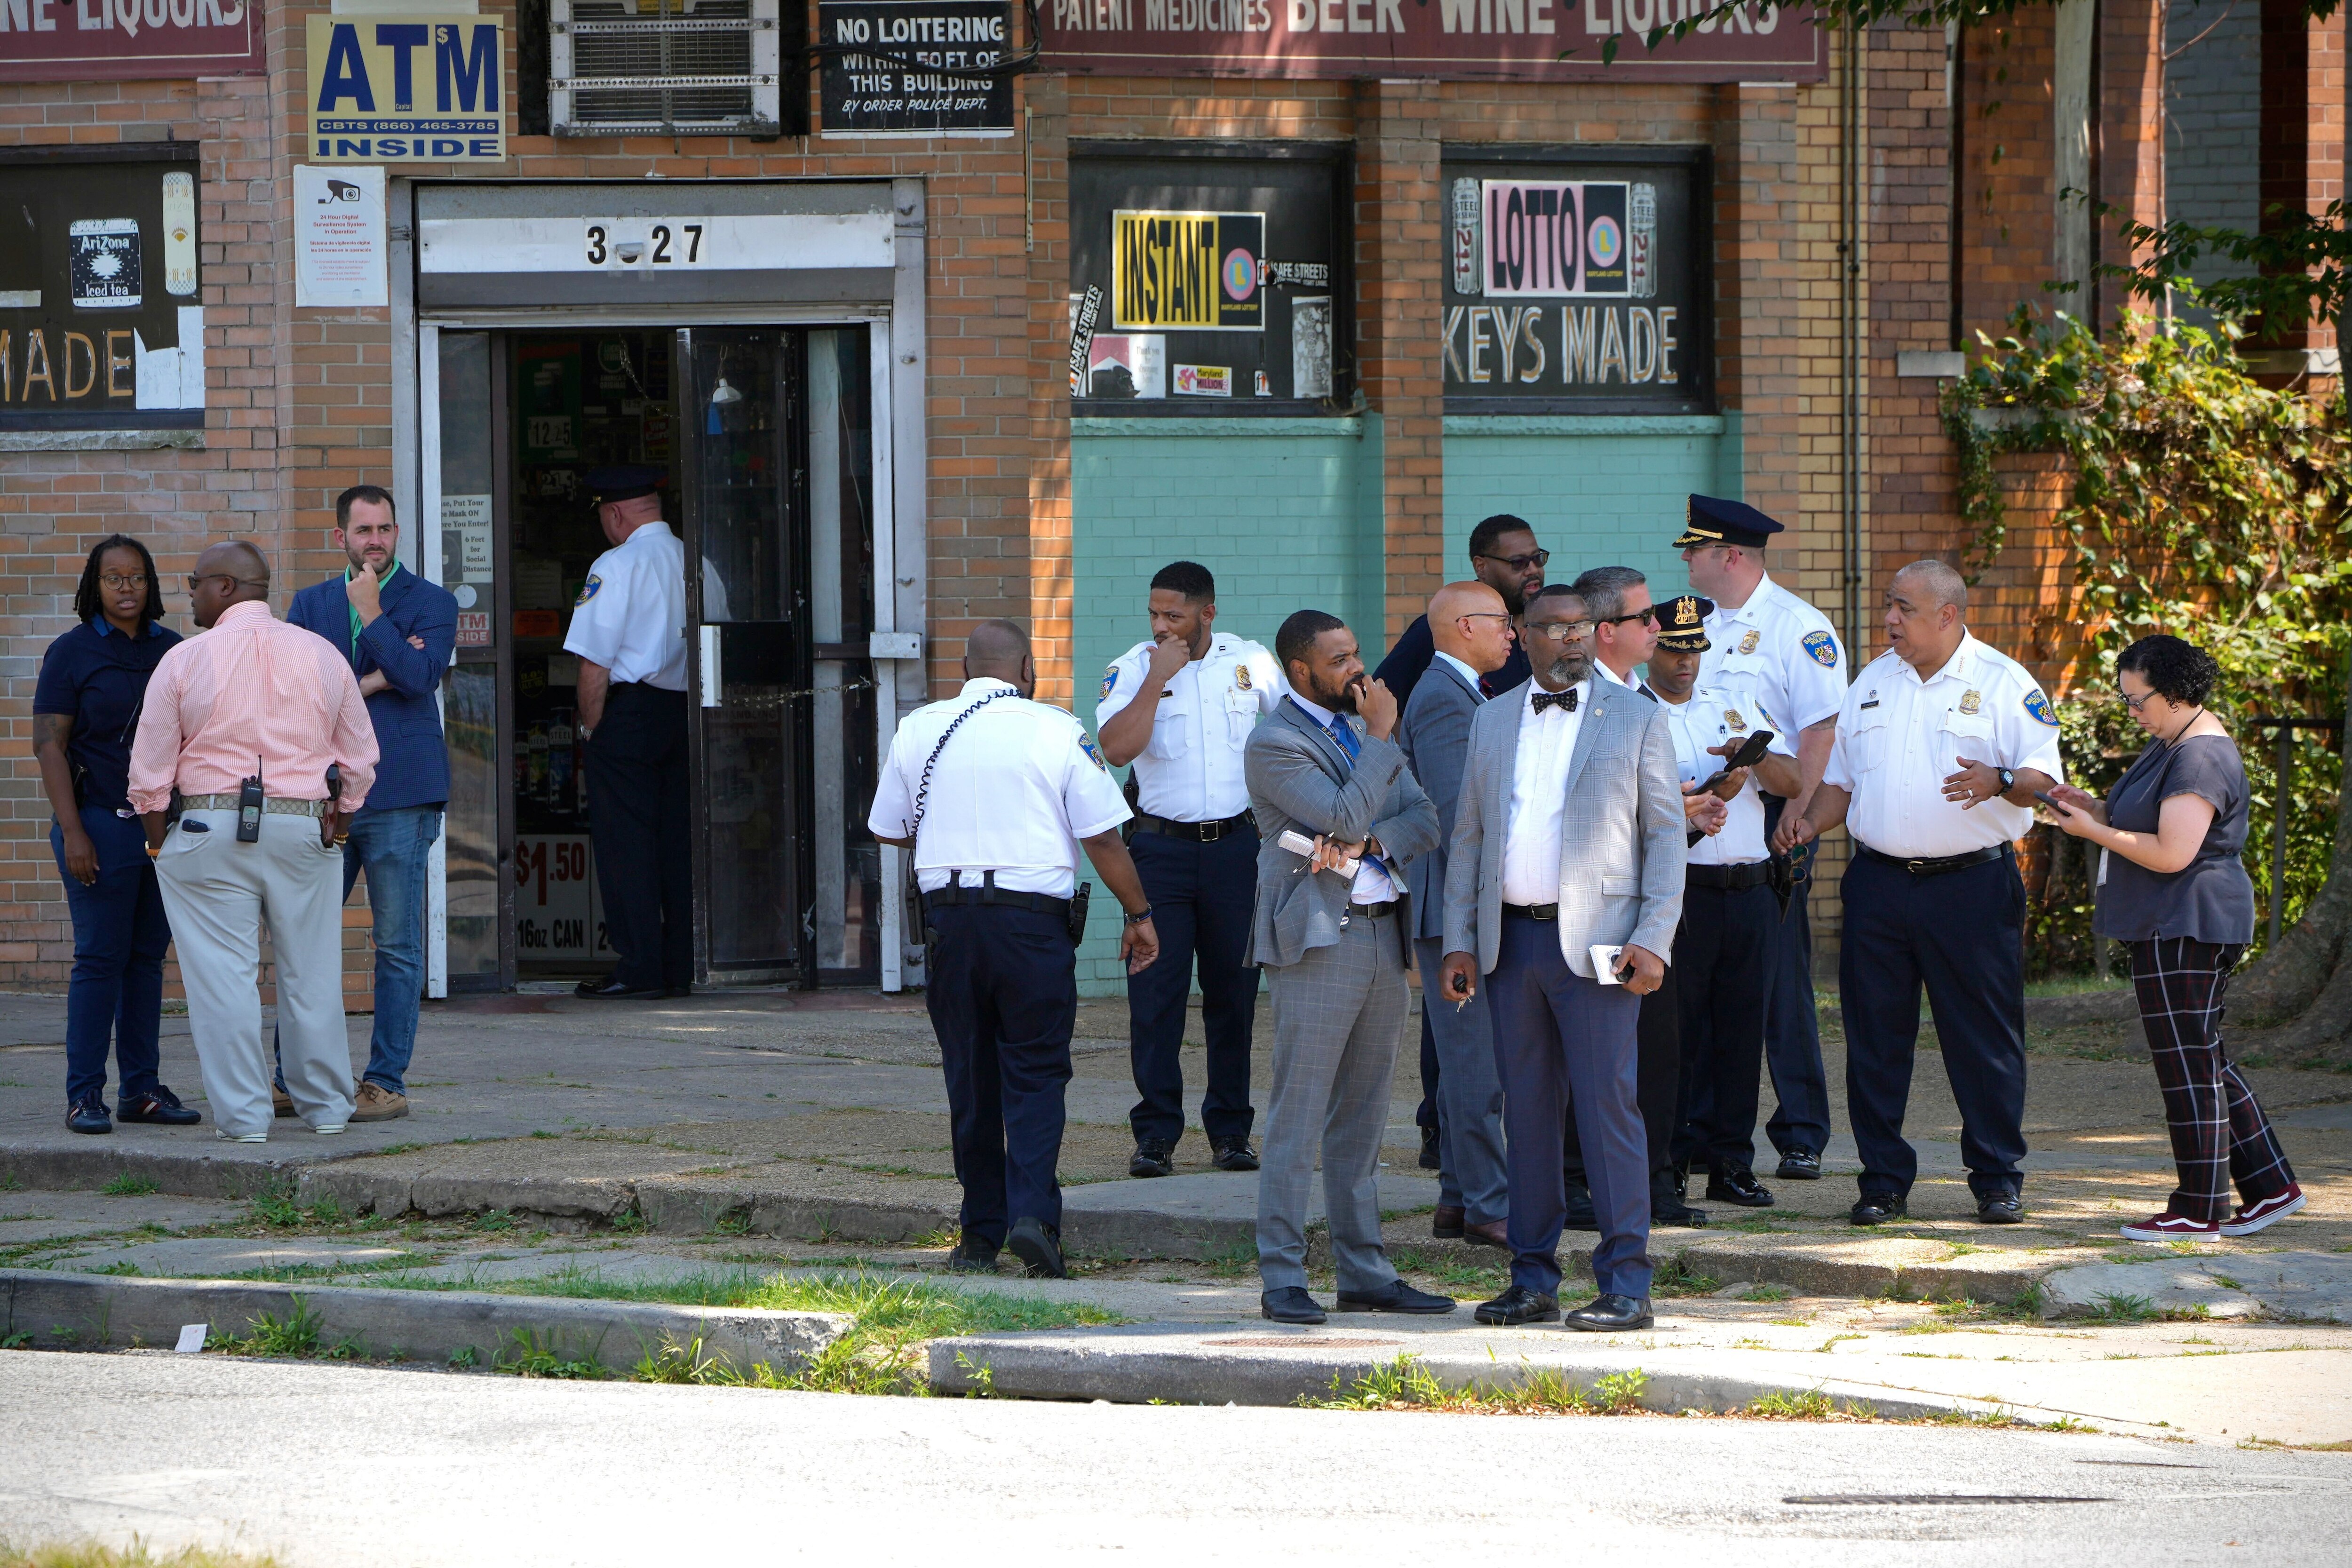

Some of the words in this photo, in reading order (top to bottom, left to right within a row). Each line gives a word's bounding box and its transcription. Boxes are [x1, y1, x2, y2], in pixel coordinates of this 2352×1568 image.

[1145, 0, 1271, 31] MEDICINES
[837, 18, 870, 43] NO
[878, 16, 1004, 43] LOITERING
[317, 24, 499, 112] ATM
[975, 51, 1000, 68] OF
[849, 75, 892, 92] THIS
[903, 74, 993, 92] BUILDING
[842, 99, 860, 112] BY
[863, 99, 902, 112] ORDER
[907, 98, 951, 111] POLICE
[954, 98, 987, 111] DEPT.
[373, 121, 415, 131] (866)
[318, 139, 499, 157] INSIDE
[1456, 201, 1478, 211] STEEL
[80, 236, 130, 254] AriZona
[587, 225, 702, 264] 327
[1492, 187, 1578, 291] LOTTO
[1122, 217, 1214, 324] INSTANT
[1294, 263, 1328, 279] STREETS
[86, 283, 107, 297] Iced
[111, 283, 128, 295] tea
[1069, 334, 1086, 367] SAFE
[1078, 284, 1099, 337] STREETS
[1441, 306, 1545, 383] KEYS
[1562, 306, 1678, 383] MADE
[1197, 368, 1223, 378] Maryland
[1197, 379, 1223, 389] MILLION
[1810, 637, 1827, 646] POLICE
[1321, 726, 1337, 743] B.P.D.
[516, 841, 585, 906] $1.50
[517, 919, 547, 948] 16oz
[553, 919, 583, 948] CAN
